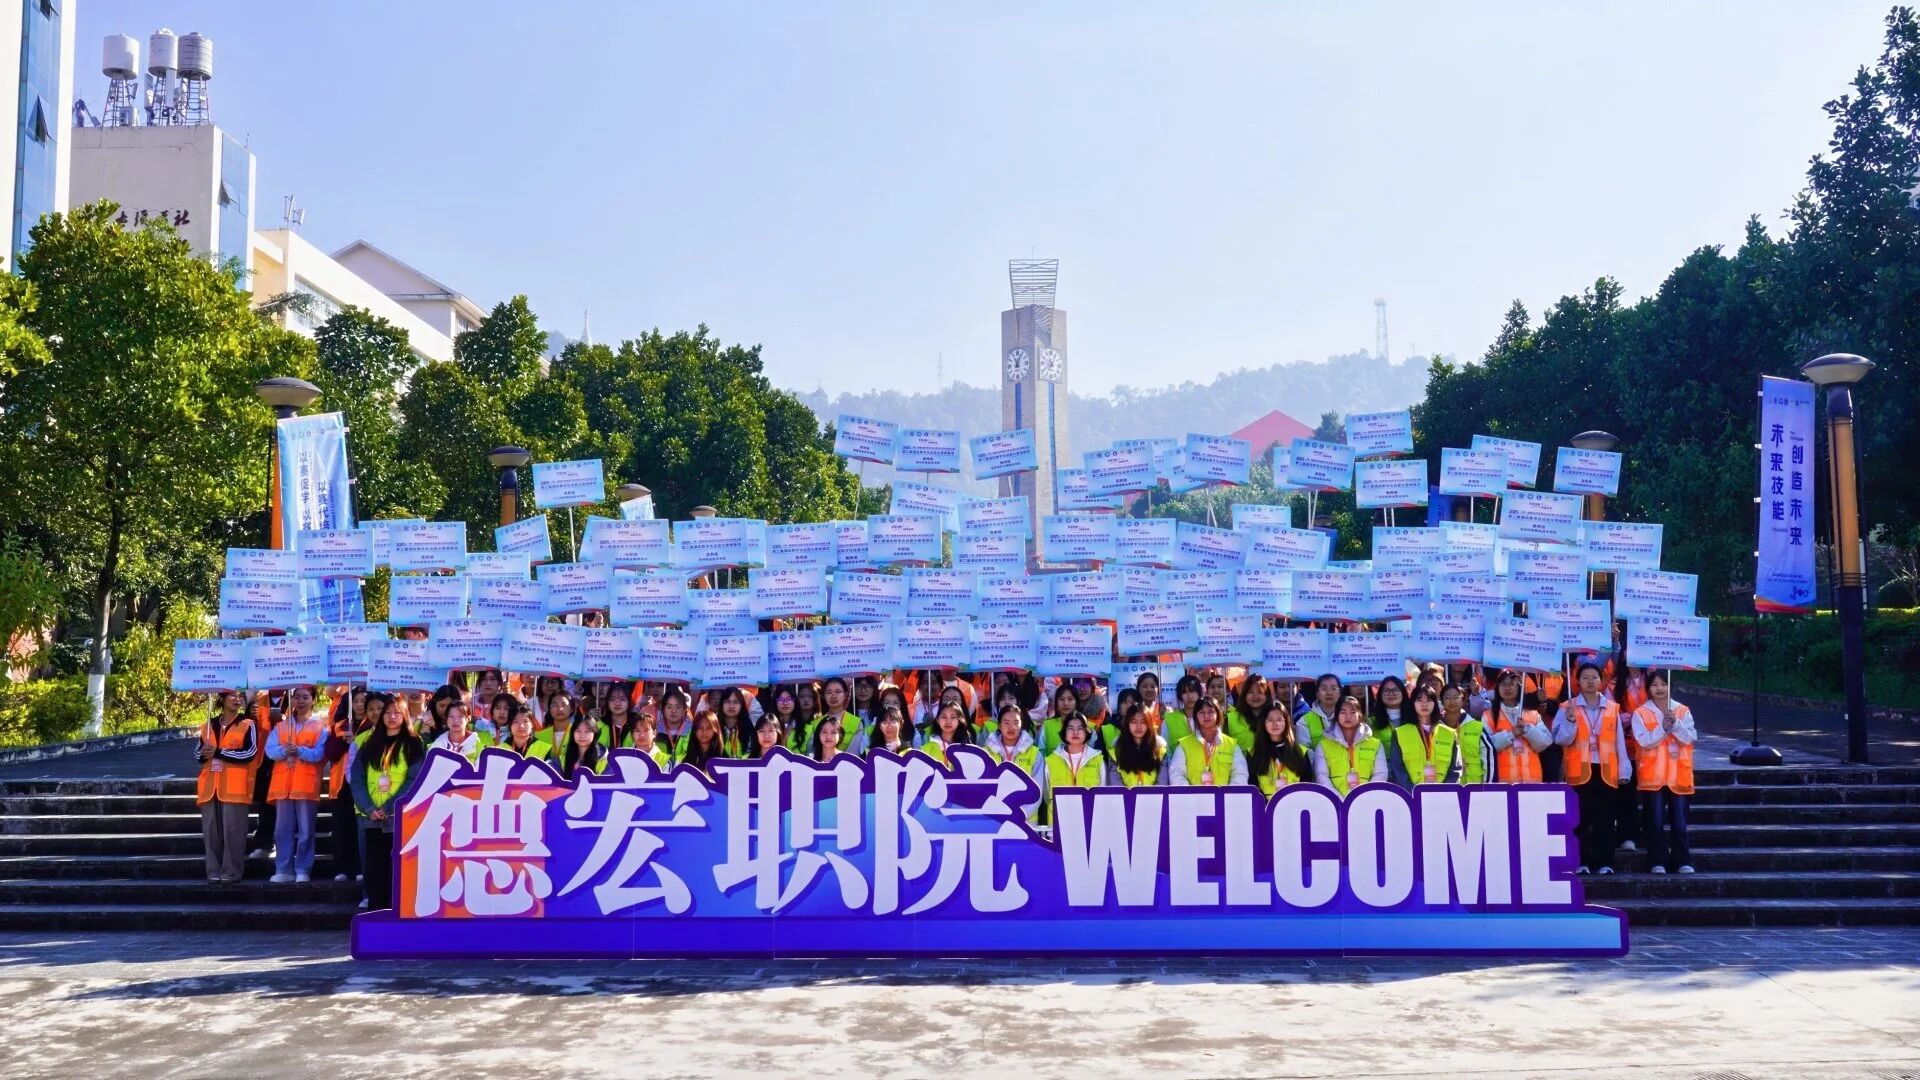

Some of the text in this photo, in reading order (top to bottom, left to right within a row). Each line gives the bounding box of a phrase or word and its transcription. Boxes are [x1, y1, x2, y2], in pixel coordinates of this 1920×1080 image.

[1770, 424, 1785, 521] 未来技能
[1789, 444, 1804, 546] 创造未来
[400, 753, 1030, 916] 德宏职院
[1055, 789, 1573, 908] WELCOME
